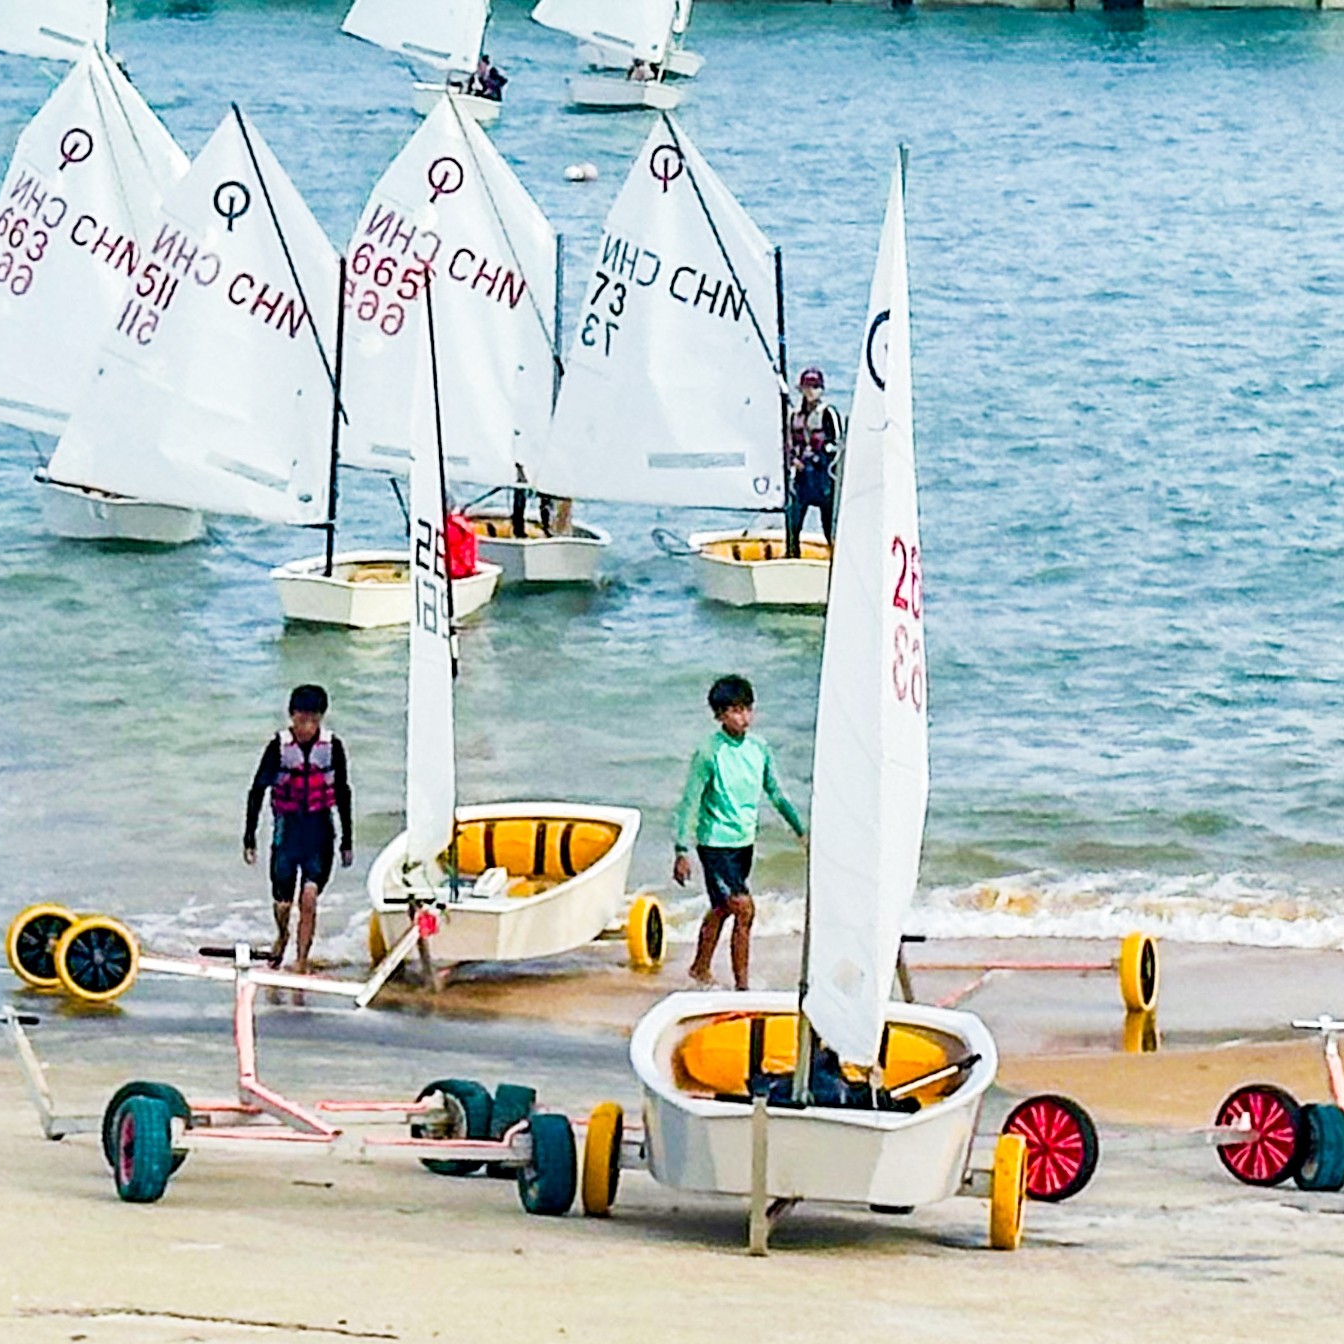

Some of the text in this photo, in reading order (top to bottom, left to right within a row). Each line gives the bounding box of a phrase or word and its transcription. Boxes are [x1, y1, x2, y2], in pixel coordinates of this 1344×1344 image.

[70, 214, 140, 277] CHN
[352, 242, 425, 300] 665
[135, 262, 179, 311] 511
[227, 272, 308, 339] CHN
[448, 247, 527, 310] CHN
[590, 270, 627, 317] 73
[669, 265, 748, 322] CHN
